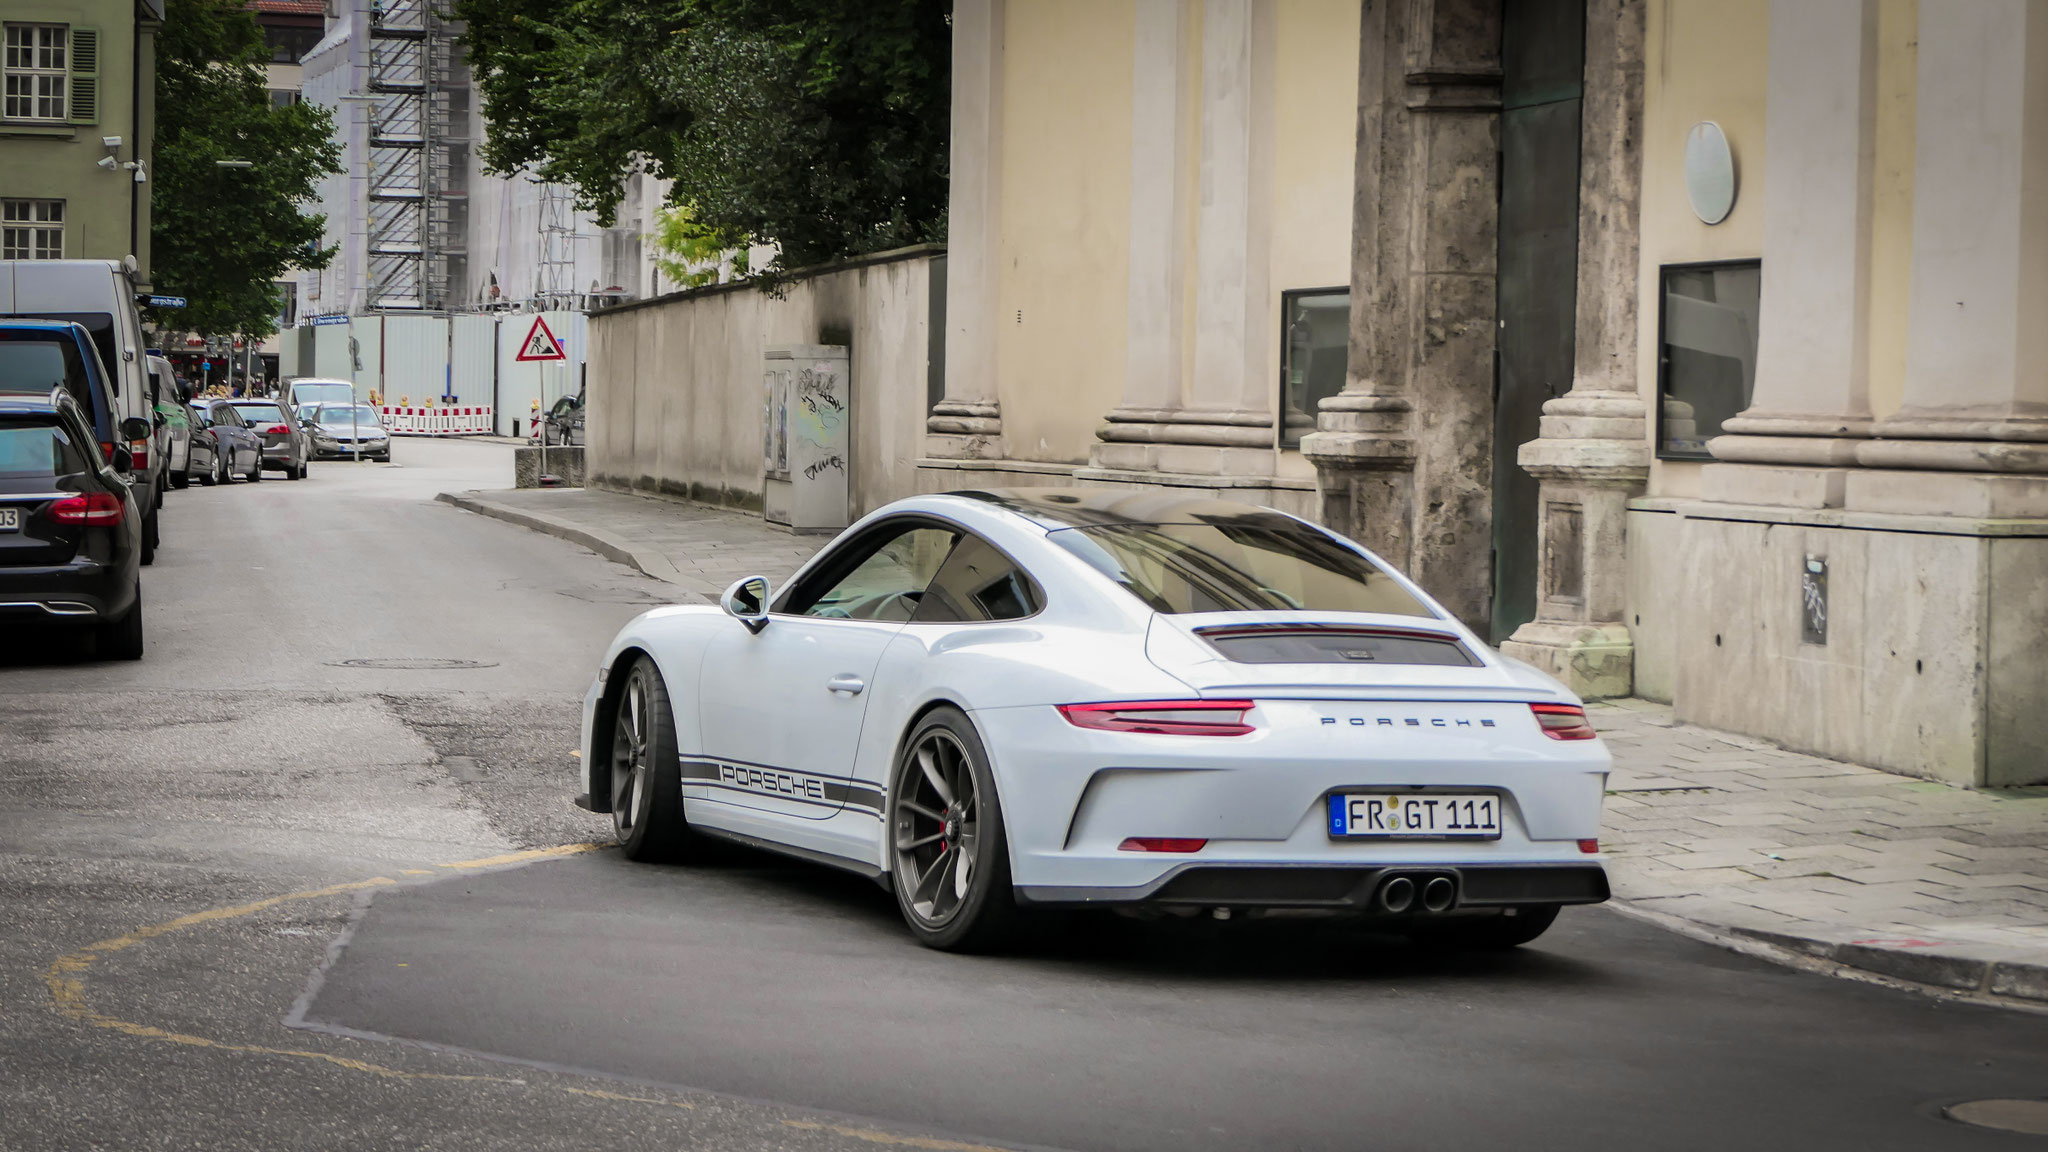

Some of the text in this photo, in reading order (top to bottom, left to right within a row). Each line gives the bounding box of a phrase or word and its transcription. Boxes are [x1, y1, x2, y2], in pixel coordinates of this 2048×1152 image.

[1320, 717, 1495, 727] PORSCHE
[722, 765, 822, 798] PORSCHE
[1350, 800, 1496, 830] FR GT 111
